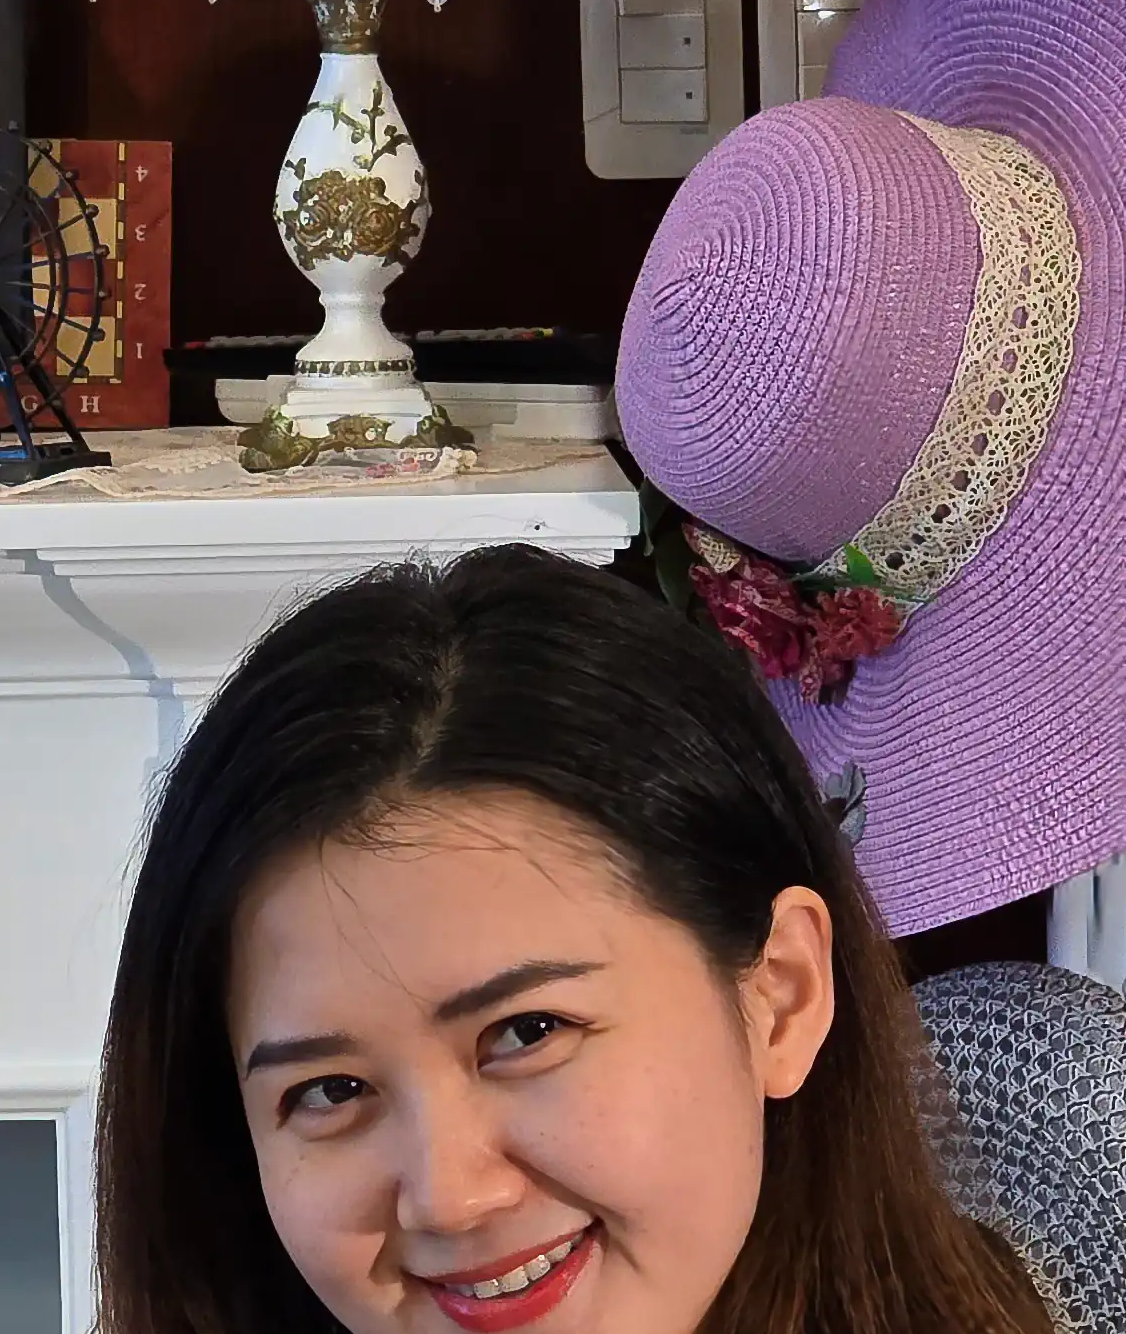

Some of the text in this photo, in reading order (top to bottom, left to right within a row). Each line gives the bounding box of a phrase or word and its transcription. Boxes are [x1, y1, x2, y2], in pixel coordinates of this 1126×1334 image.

[135, 165, 149, 182] 4
[135, 224, 147, 241] 3
[134, 283, 147, 301] 2
[21, 395, 38, 411] G
[80, 395, 100, 413] H
